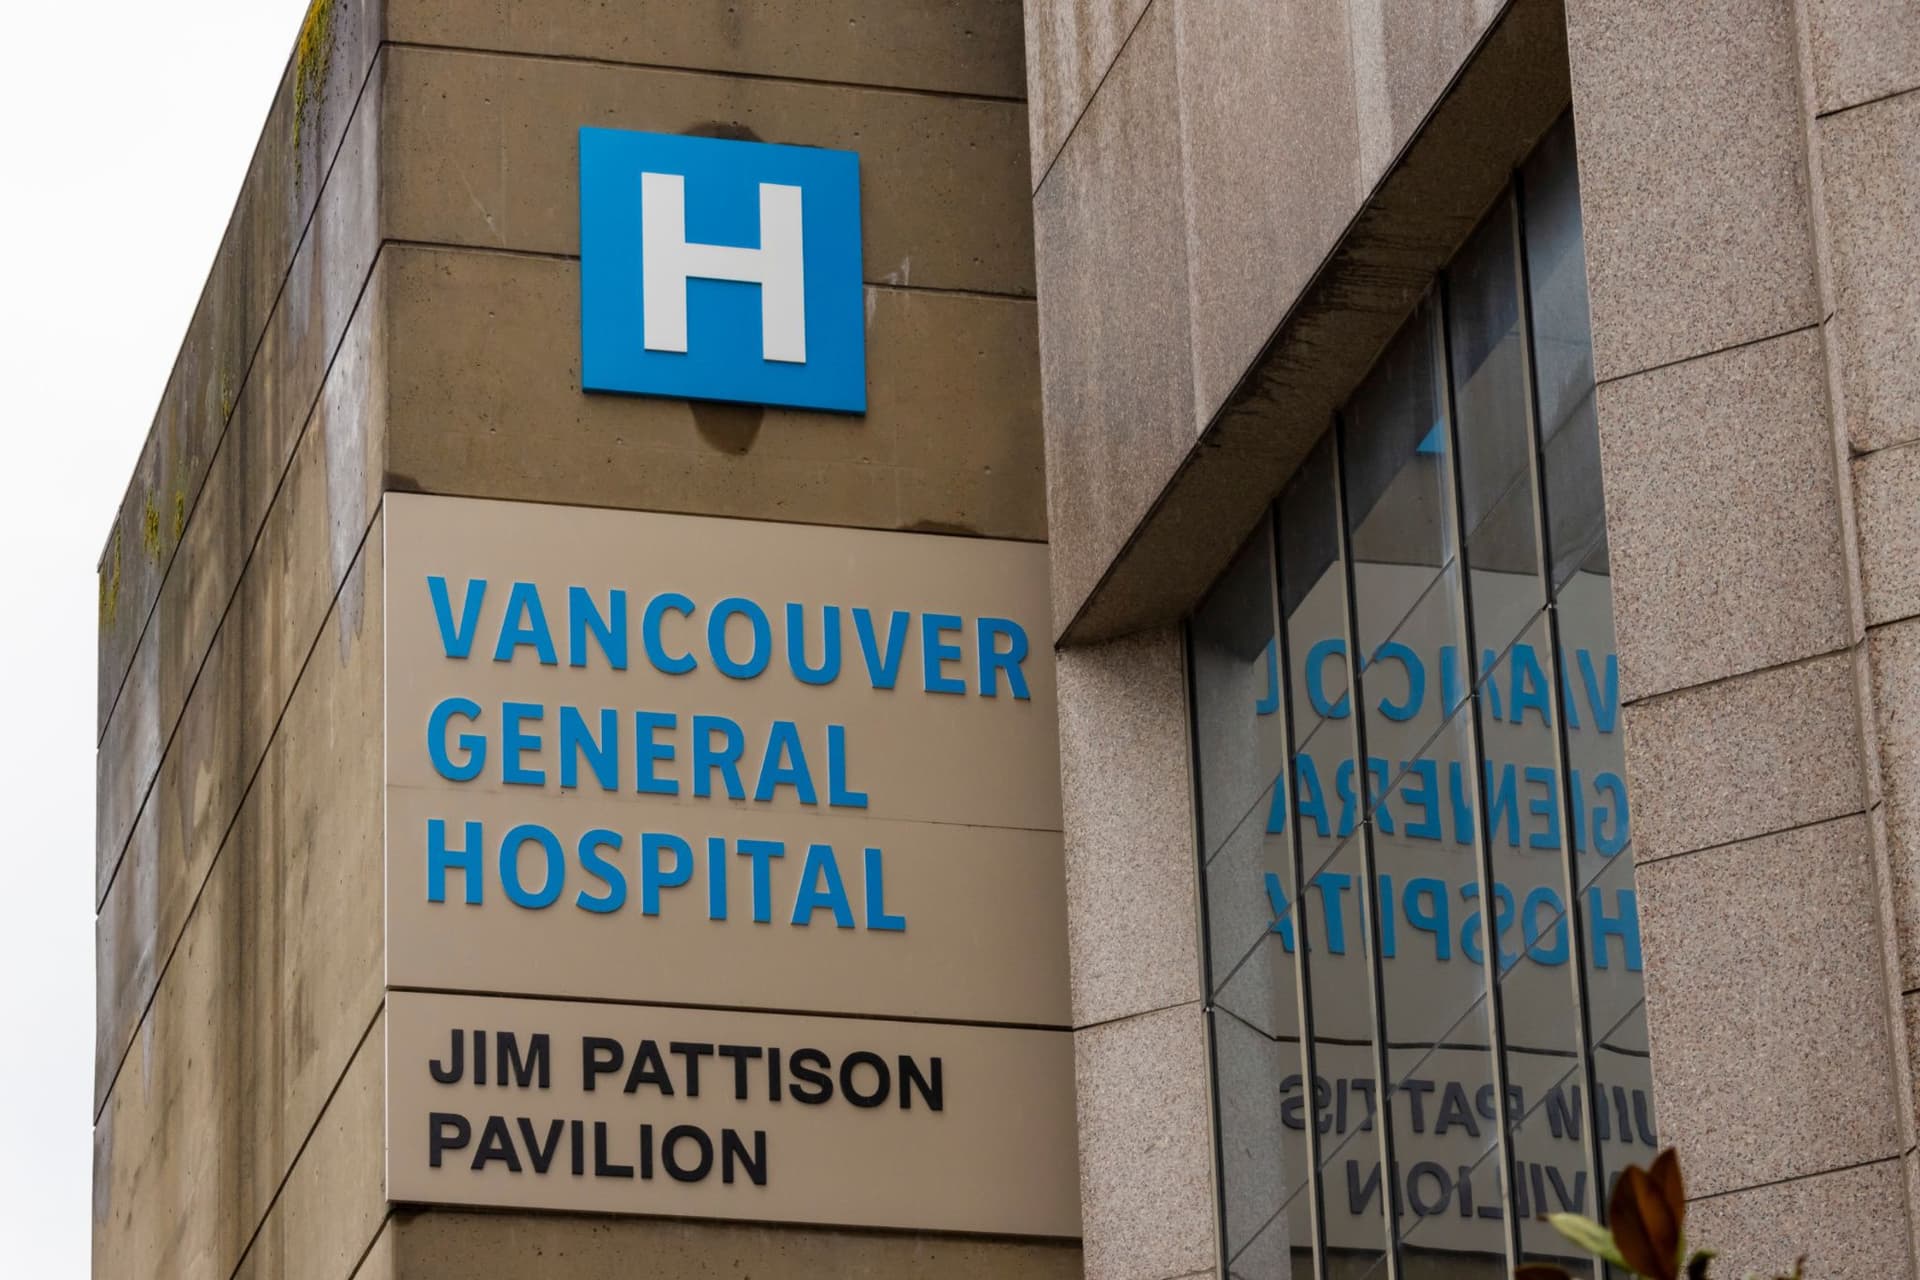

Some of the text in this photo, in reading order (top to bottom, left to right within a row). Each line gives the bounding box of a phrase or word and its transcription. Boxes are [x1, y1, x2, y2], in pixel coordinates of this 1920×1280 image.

[641, 171, 806, 363] H
[427, 575, 1030, 699] VANCOUVER
[427, 697, 868, 808] GENERAL
[427, 819, 906, 931] HOSPITAL
[428, 1028, 944, 1113] JIM PATTISON
[428, 1111, 768, 1187] PAVILION
